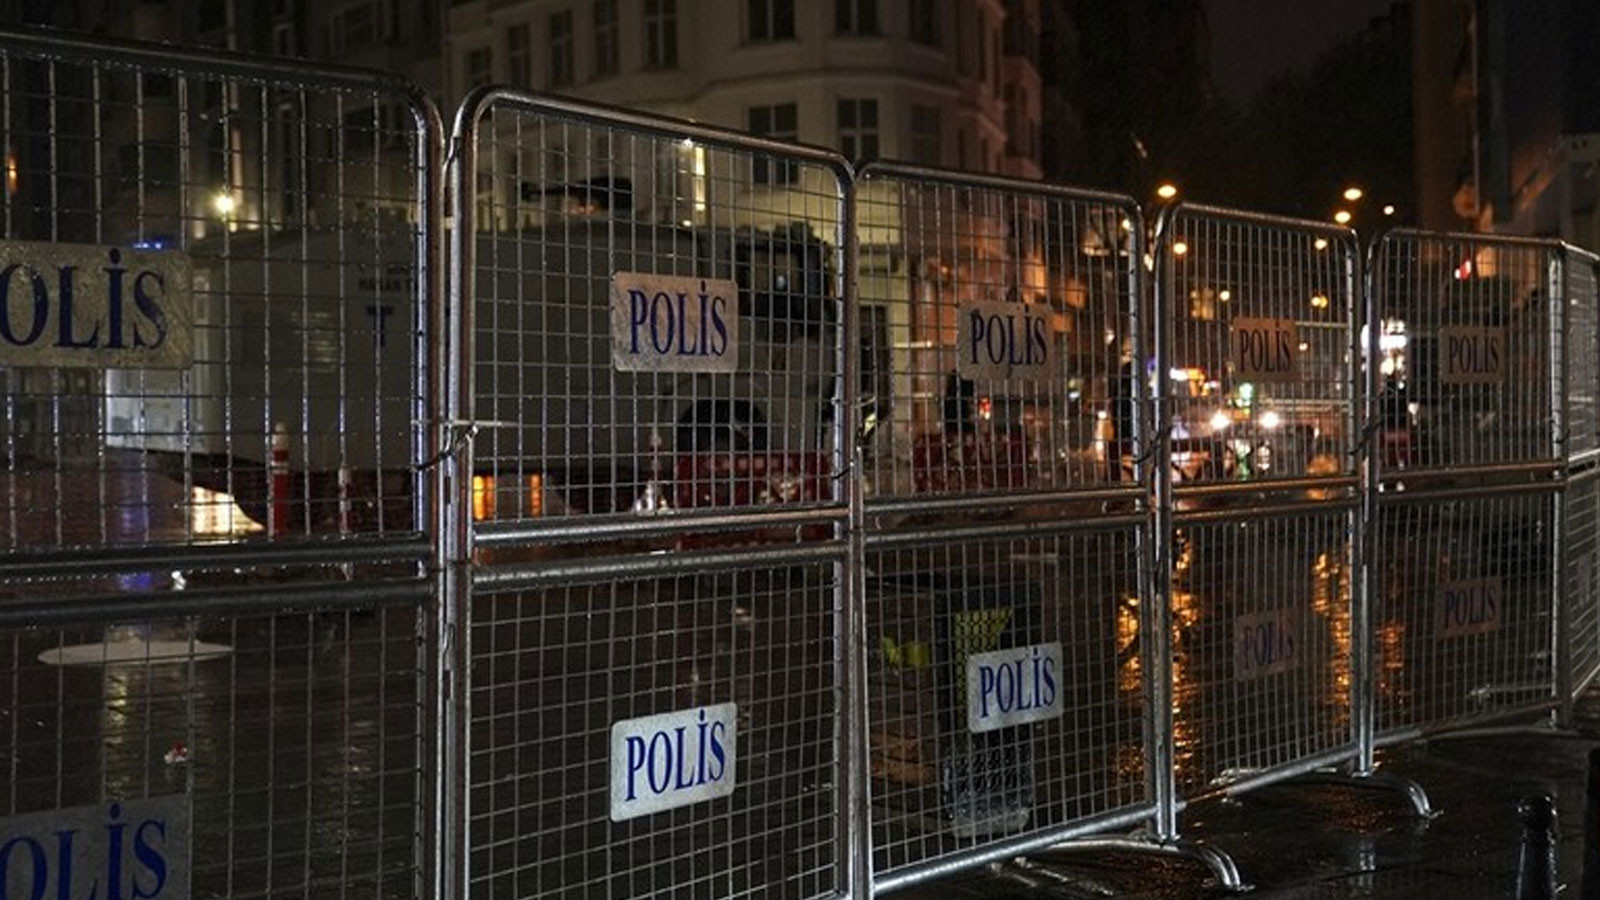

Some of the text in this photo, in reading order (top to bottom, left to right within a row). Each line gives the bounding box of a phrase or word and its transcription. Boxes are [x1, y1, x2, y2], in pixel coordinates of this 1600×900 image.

[628, 281, 727, 356] POLİS
[971, 304, 1047, 365] POLİS
[1239, 322, 1291, 373] POLİS
[1449, 328, 1498, 373] POLİS
[1444, 581, 1495, 628] POLİS
[980, 647, 1055, 717] POLİS
[625, 709, 724, 801] POLİS
